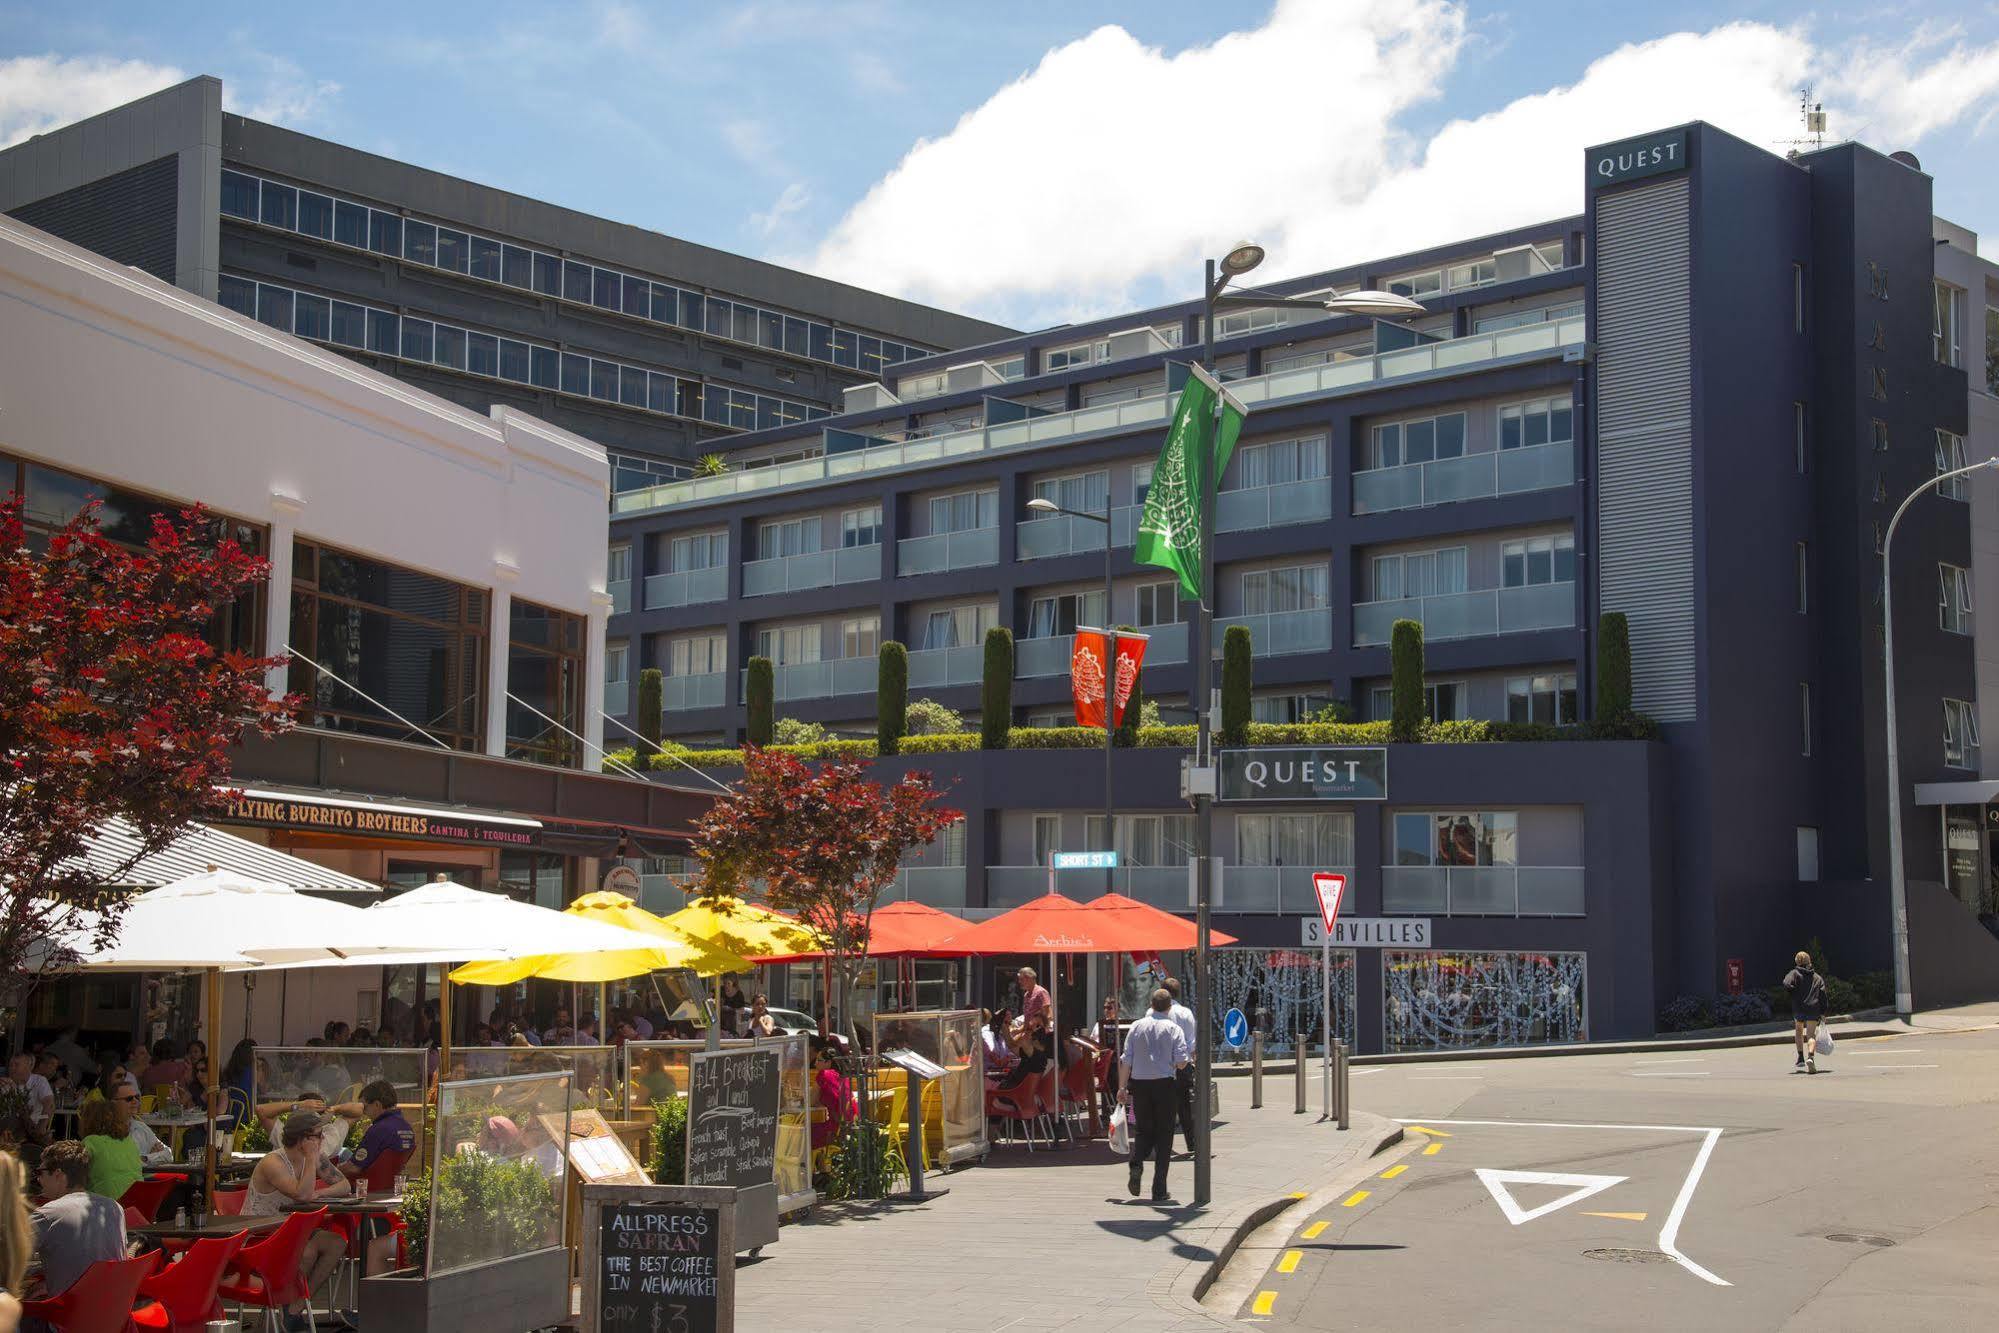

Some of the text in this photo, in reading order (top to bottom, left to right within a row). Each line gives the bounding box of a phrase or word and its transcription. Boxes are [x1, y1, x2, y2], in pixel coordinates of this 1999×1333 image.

[1598, 143, 1678, 177] QUEST
[1245, 761, 1360, 788] QUEST
[1312, 785, 1355, 793] Newmarket
[227, 800, 286, 821] FLYING
[289, 805, 354, 827] BURRITO
[356, 810, 427, 835] BROTHERS
[429, 825, 469, 838] CANTINA
[482, 830, 532, 844] TEQUILERIA
[1060, 854, 1103, 867] SHORT ST
[1323, 884, 1336, 897] GIVE
[1308, 922, 1424, 942] SRVILLES
[695, 1058, 718, 1092] $14
[612, 1214, 708, 1235] ALLPRESS
[618, 1232, 701, 1252] SAFRAN
[606, 1256, 713, 1275] THE BEST COFFEE
[608, 1274, 718, 1297] IN NEWMARKET
